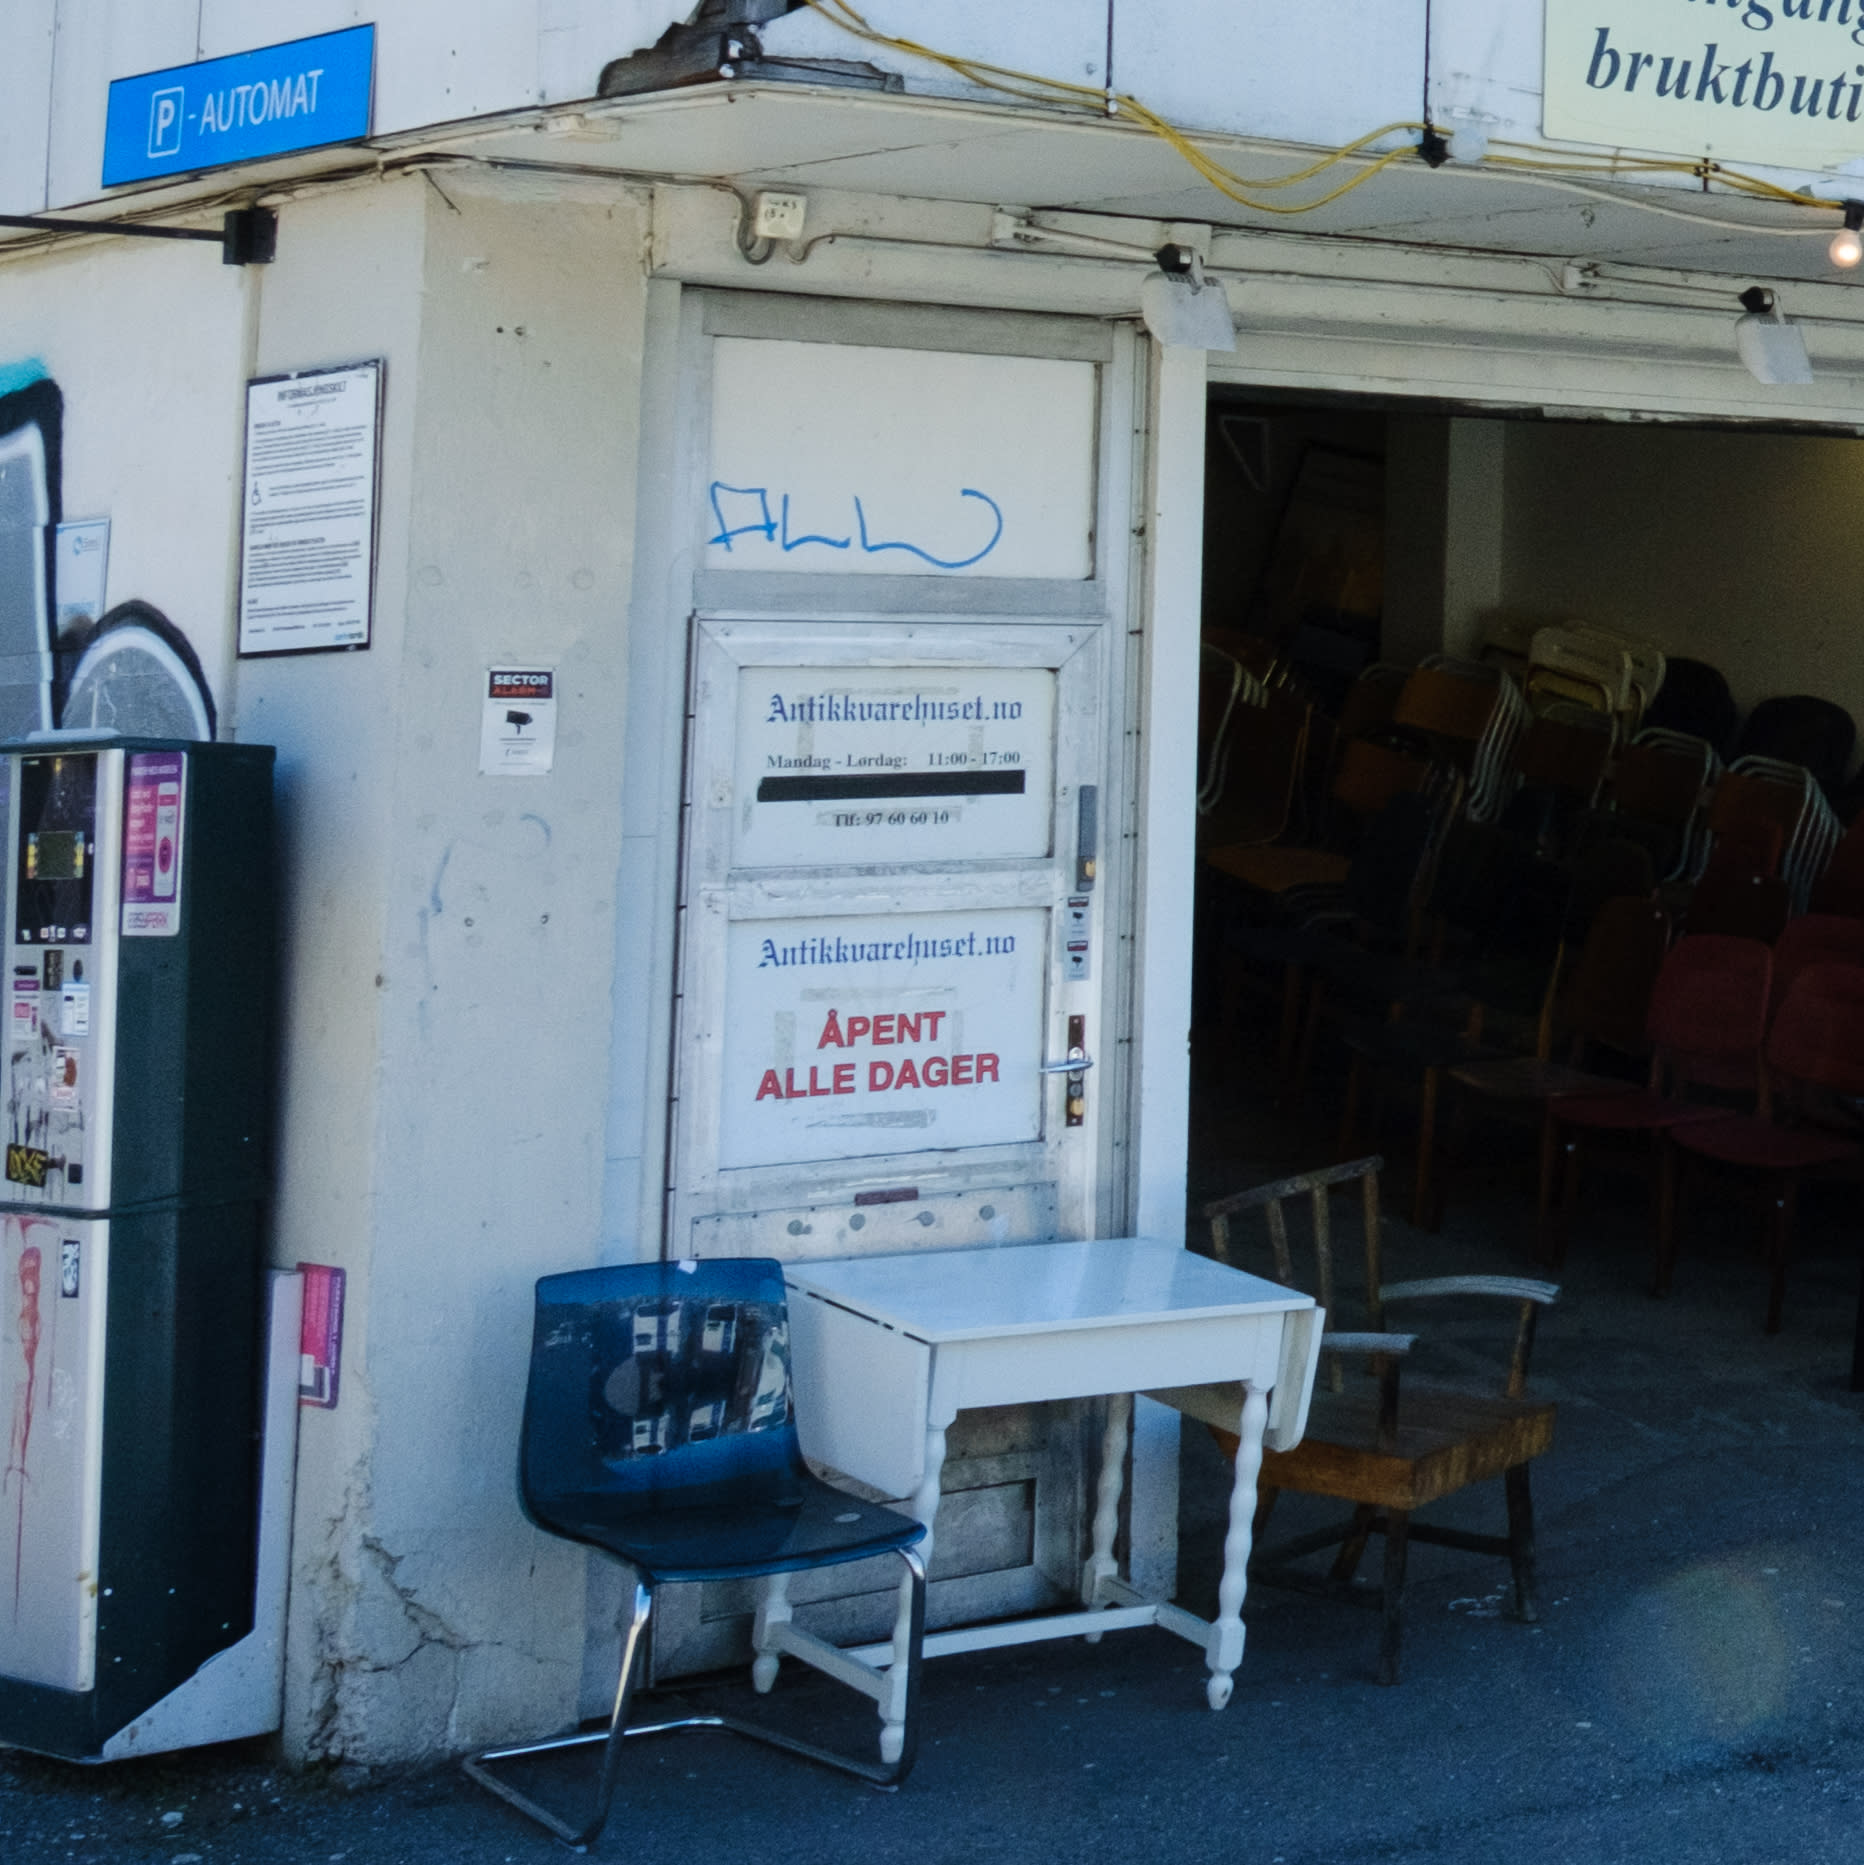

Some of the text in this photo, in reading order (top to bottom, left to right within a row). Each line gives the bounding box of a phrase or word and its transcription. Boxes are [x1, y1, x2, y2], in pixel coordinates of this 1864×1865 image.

[200, 69, 324, 136] AUTOMAT
[493, 674, 549, 685] SECTOR
[766, 693, 1023, 727] Antikkvarehuset.no
[767, 754, 831, 770] Mandag
[928, 752, 967, 766] 11:00
[982, 751, 1021, 765] 17:00
[834, 811, 950, 827] Tlf: 97 60 60 10
[758, 932, 1016, 967] Antikkvarehuset.no
[817, 1008, 947, 1050] ÅPENT
[755, 1053, 1001, 1101] ALLE DAGER
